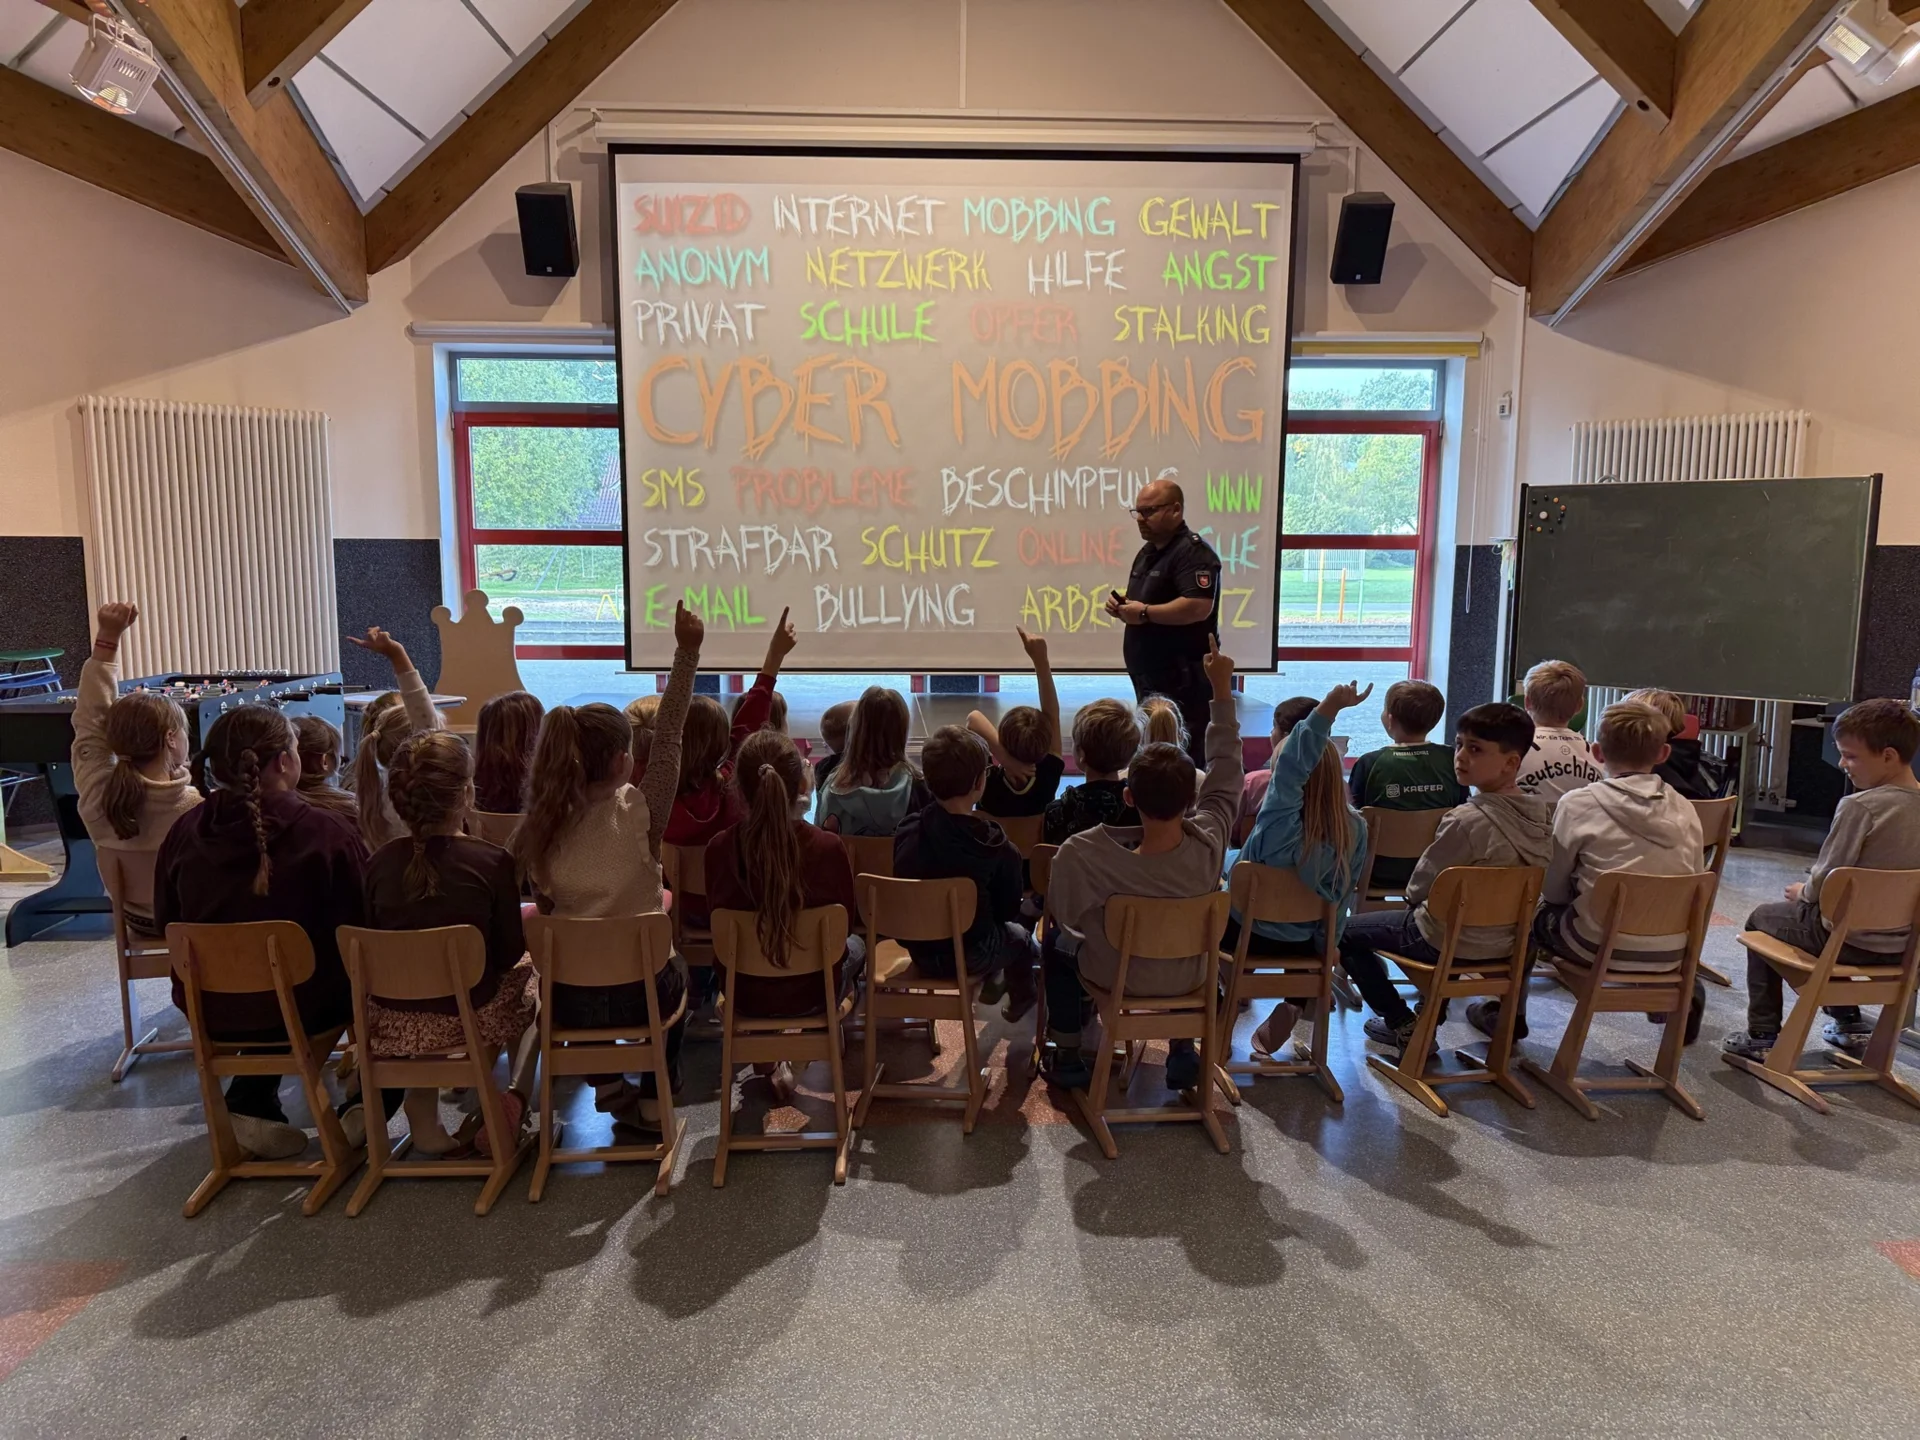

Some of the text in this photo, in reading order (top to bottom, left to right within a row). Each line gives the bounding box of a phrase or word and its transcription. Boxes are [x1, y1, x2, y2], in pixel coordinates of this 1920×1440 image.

[633, 193, 1280, 244] SUIZID INTERNET MOBBING GEWALT
[634, 245, 1277, 296] ANONYM NETZWERK HILFE ANGST
[632, 299, 1270, 350] PRIVAT SCHULE OPFER STALKING
[637, 353, 1264, 462] CYBER MOBBING
[641, 466, 706, 510] SMS
[729, 465, 915, 515] PROBLEME
[1206, 467, 1263, 514] WWW
[643, 524, 839, 575] STRAFBAR
[861, 525, 999, 574] SCHUTZ
[1016, 526, 1125, 567] ONLINE
[644, 583, 767, 632] E-MAIL
[814, 583, 975, 633] BULLYING
[1403, 784, 1444, 793] KAEFER
